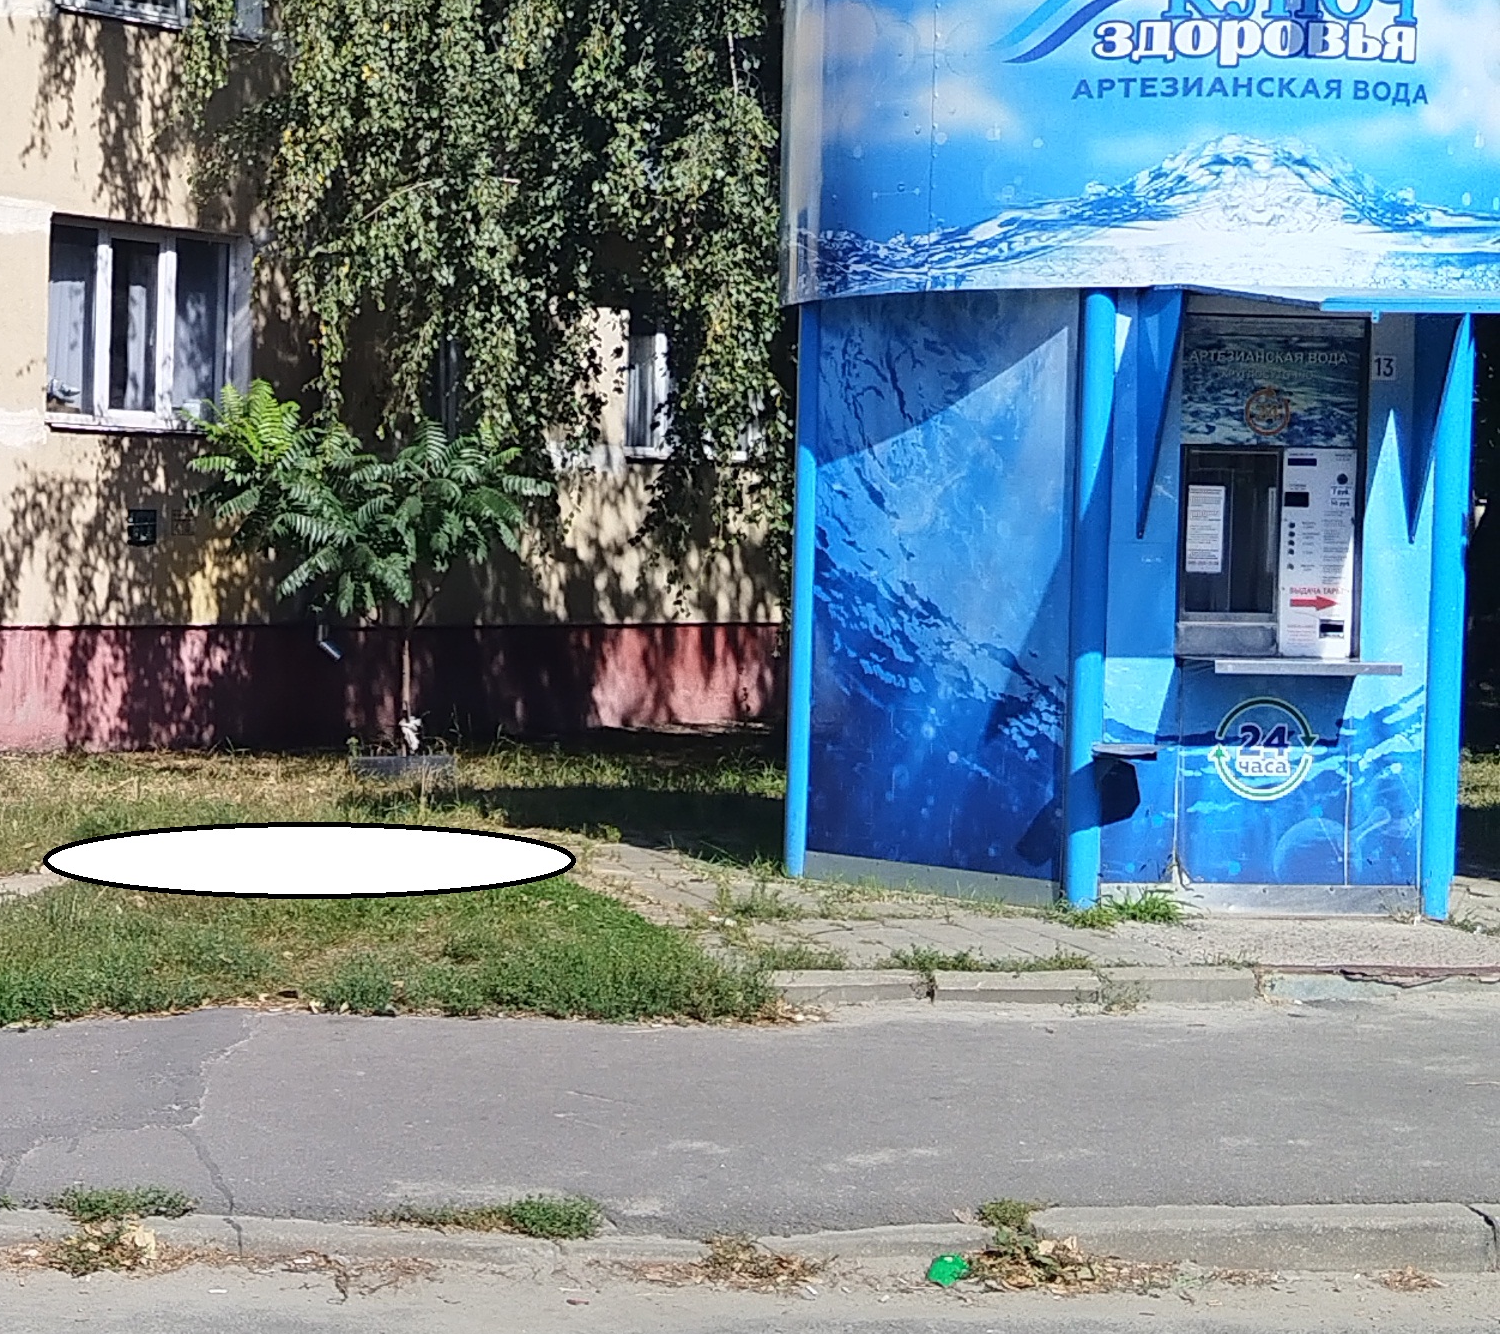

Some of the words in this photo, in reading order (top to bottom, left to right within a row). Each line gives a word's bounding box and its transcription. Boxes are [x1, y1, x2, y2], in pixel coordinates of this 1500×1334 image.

[1092, 19, 1418, 67] здоровья
[1071, 76, 1343, 101] АРТЕЗИАНСКАЯ
[1353, 80, 1430, 107] ВОДА
[1189, 349, 1304, 364] АРТЕЗИАНСКАЯ
[1308, 351, 1349, 366] ВОДА
[1374, 357, 1394, 378] 13
[1239, 723, 1290, 757] 24
[1238, 761, 1288, 774] часа
